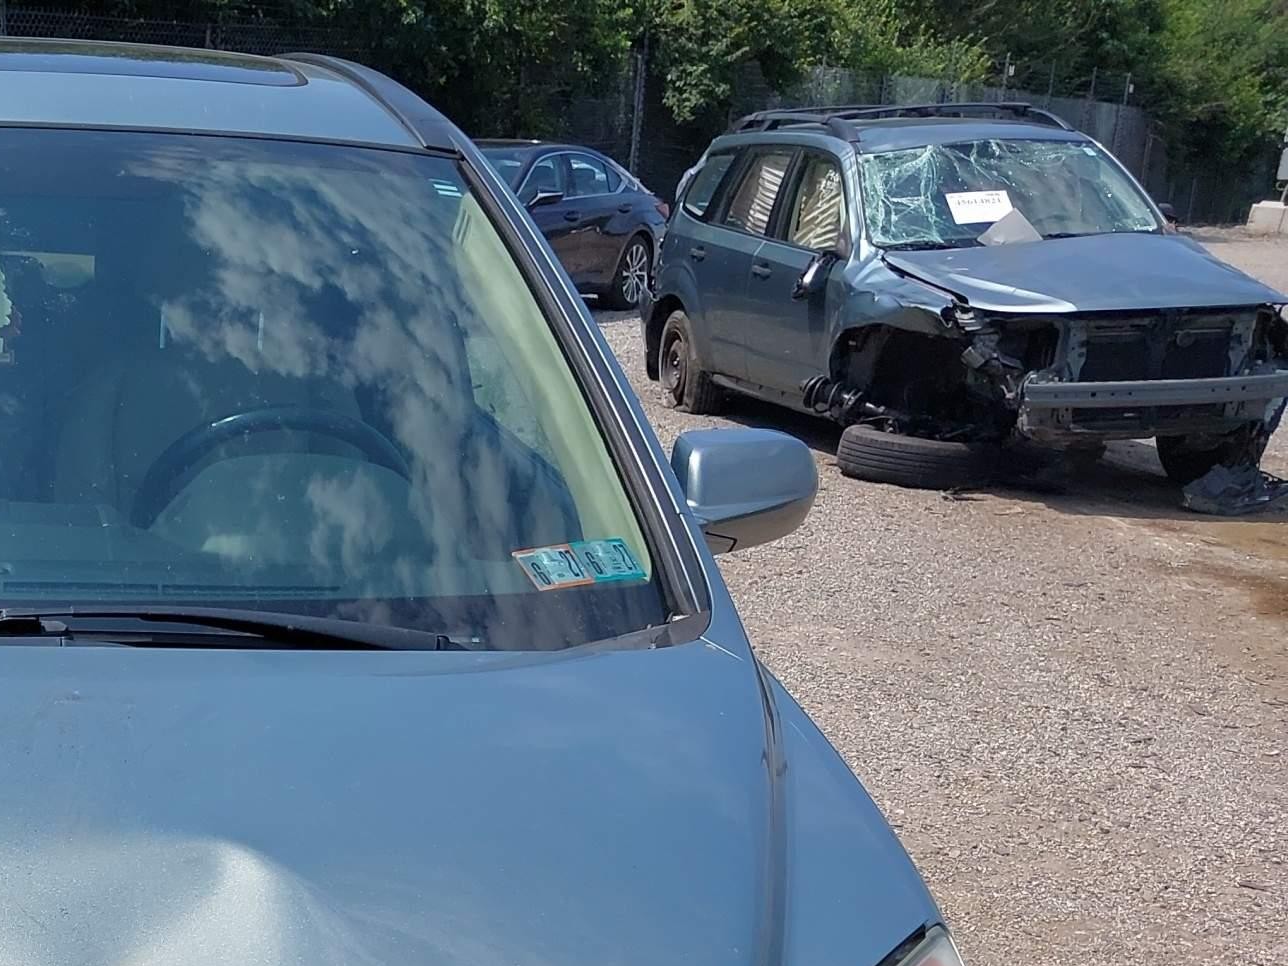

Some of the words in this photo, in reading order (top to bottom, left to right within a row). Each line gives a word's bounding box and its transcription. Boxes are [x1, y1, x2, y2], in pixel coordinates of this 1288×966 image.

[530, 562, 551, 585] 6
[558, 549, 585, 579] 27
[585, 551, 604, 575] 6
[612, 543, 638, 571] 27
